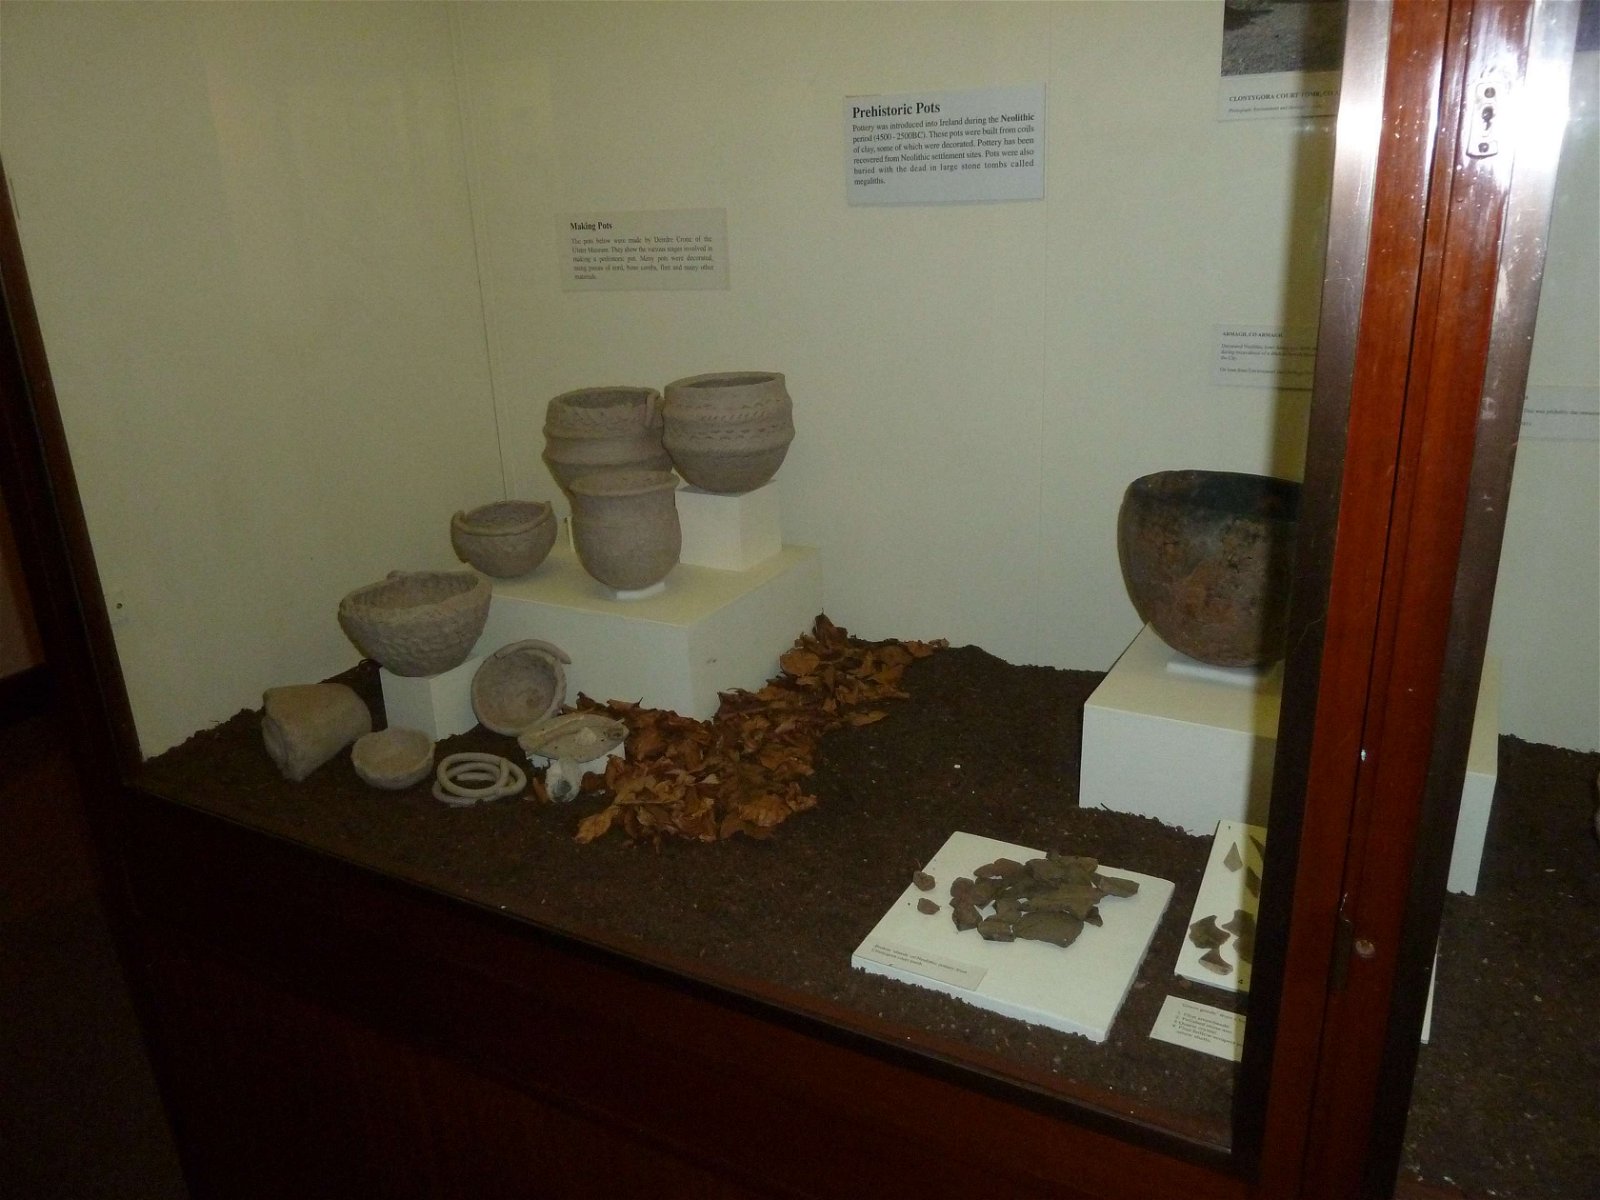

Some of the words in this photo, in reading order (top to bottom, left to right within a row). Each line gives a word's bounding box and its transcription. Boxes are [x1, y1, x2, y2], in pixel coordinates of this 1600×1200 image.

[852, 103, 912, 118] Prehistoric
[916, 102, 940, 114] Pots
[890, 121, 924, 130] introduced
[940, 118, 963, 126] Ireland
[964, 117, 986, 125] during
[1001, 113, 1035, 123] Neolithic
[853, 135, 872, 144] period
[929, 130, 948, 138] These
[950, 130, 963, 138] pots
[982, 127, 997, 135] built
[978, 139, 1001, 148] Pottery
[853, 156, 883, 164] recovered
[901, 152, 930, 161] Neolithic
[932, 151, 965, 160] settlement
[941, 162, 958, 172] large
[985, 160, 1007, 168] tombs
[1011, 159, 1034, 167] called
[854, 177, 885, 186] megaliths.
[570, 222, 596, 230] Making
